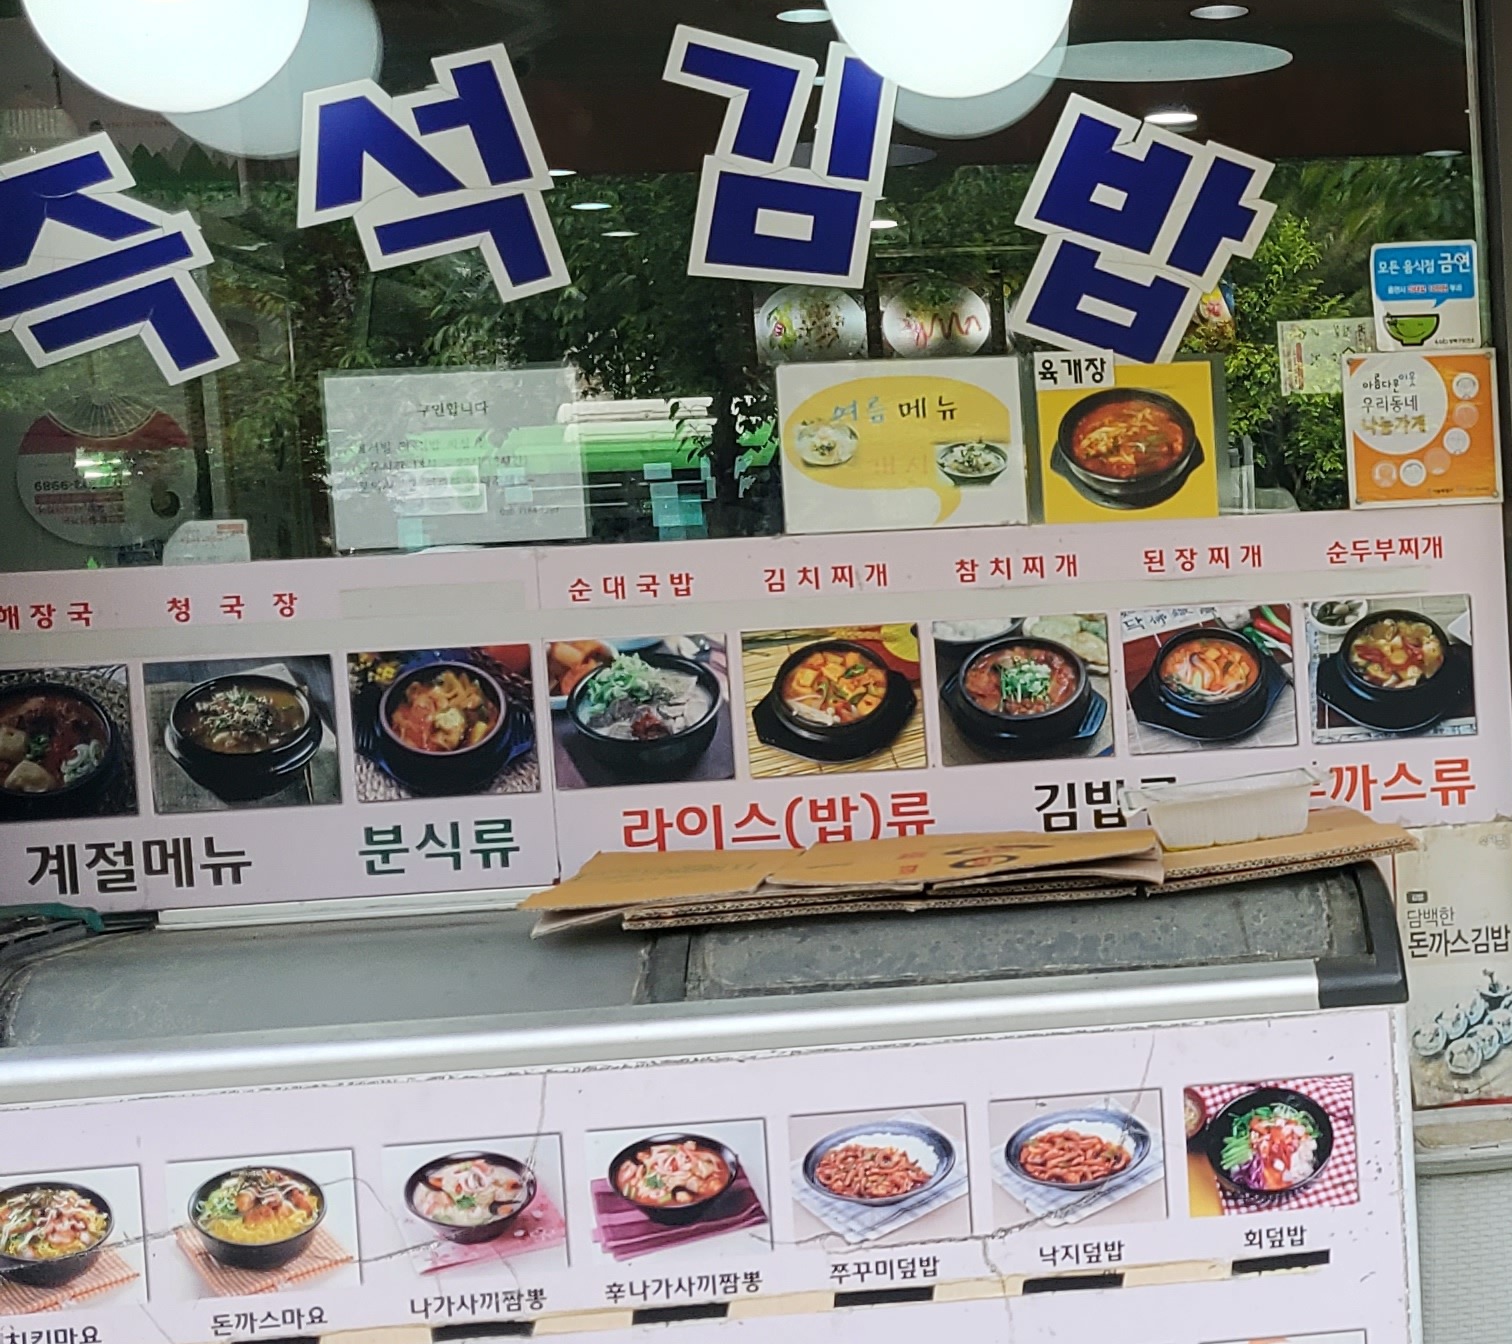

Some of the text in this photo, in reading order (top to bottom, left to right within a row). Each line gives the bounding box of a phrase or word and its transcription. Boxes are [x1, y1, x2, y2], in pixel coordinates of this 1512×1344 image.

[1438, 251, 1470, 274] 금연
[1038, 357, 1107, 385] 육개장
[898, 395, 959, 422] 메뉴
[1361, 396, 1418, 414] 우리동네
[1142, 543, 1264, 575] 된장찌개
[1325, 535, 1445, 565] 순두부찌개
[763, 561, 890, 595] 김치찌개
[954, 552, 1079, 584] 참치찌개
[568, 572, 695, 604] 순대국밥
[622, 791, 936, 852] 라이스(밥)류
[358, 817, 521, 876] 분식류
[27, 835, 253, 896] 계절메뉴
[1407, 906, 1455, 928] 담백한
[1408, 924, 1511, 959] 돈까스김밥
[1038, 1239, 1125, 1265] 낙지덮밥
[1243, 1224, 1307, 1250] 회덮밥
[829, 1255, 941, 1282] 쭈꾸미덮밥
[410, 1288, 547, 1319] 나가사끼짬뽕
[210, 1305, 328, 1338] 돈까스마요
